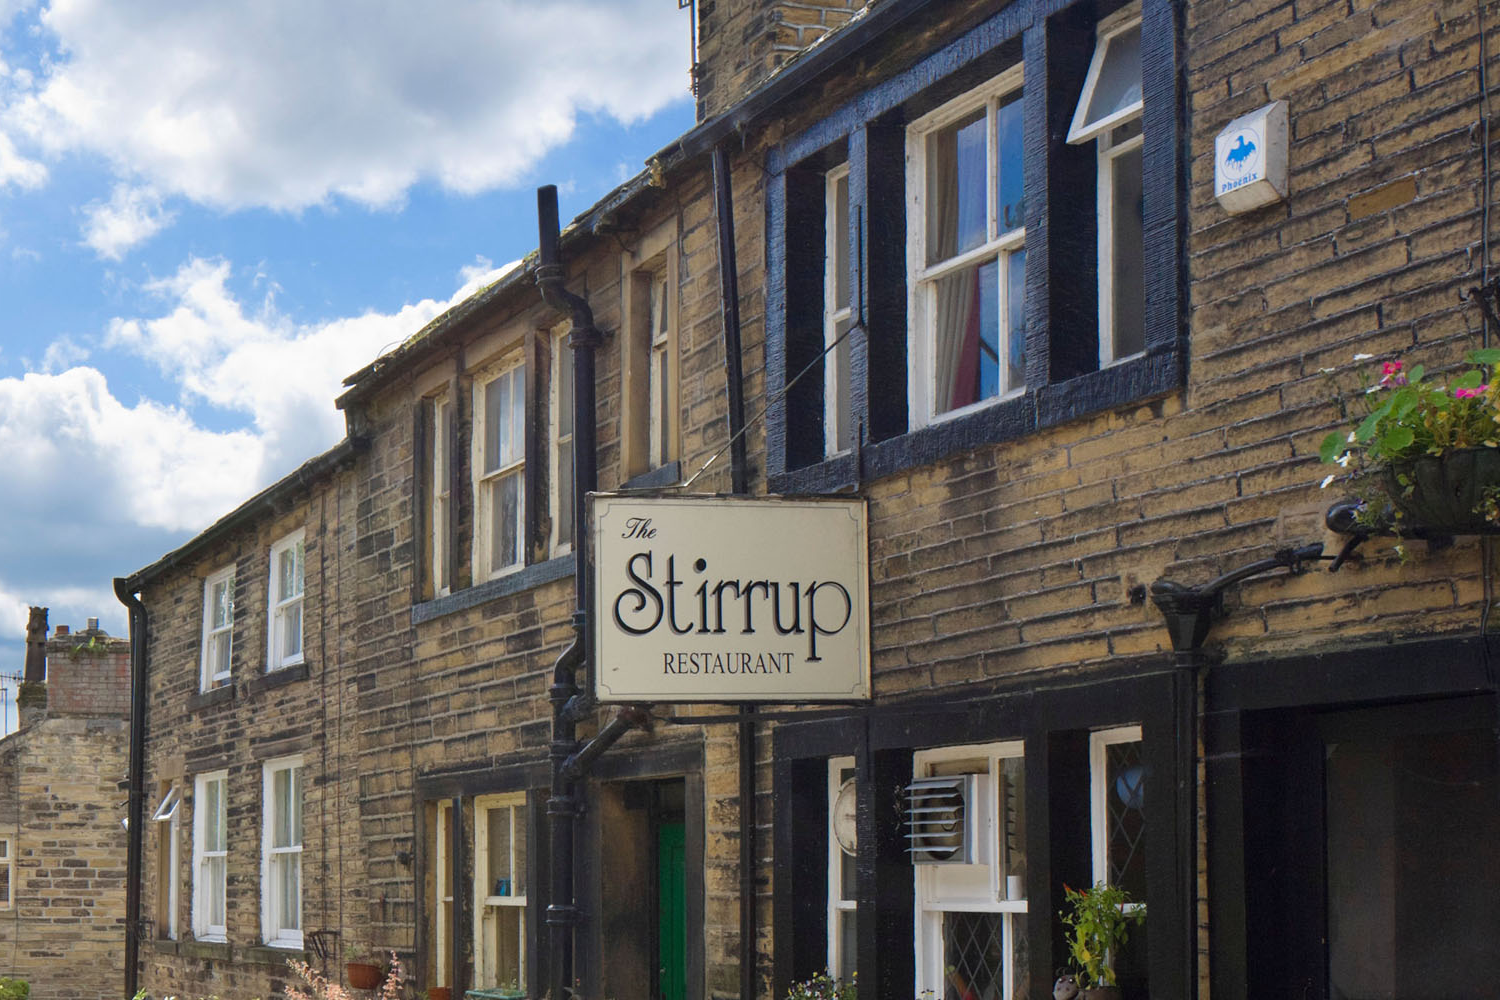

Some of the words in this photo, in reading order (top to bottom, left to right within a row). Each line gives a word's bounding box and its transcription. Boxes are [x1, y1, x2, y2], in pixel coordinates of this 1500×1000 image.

[1221, 172, 1258, 193] Phoenix
[621, 517, 658, 540] The
[612, 550, 852, 662] Stirrup
[663, 652, 795, 674] RESTAURANT
